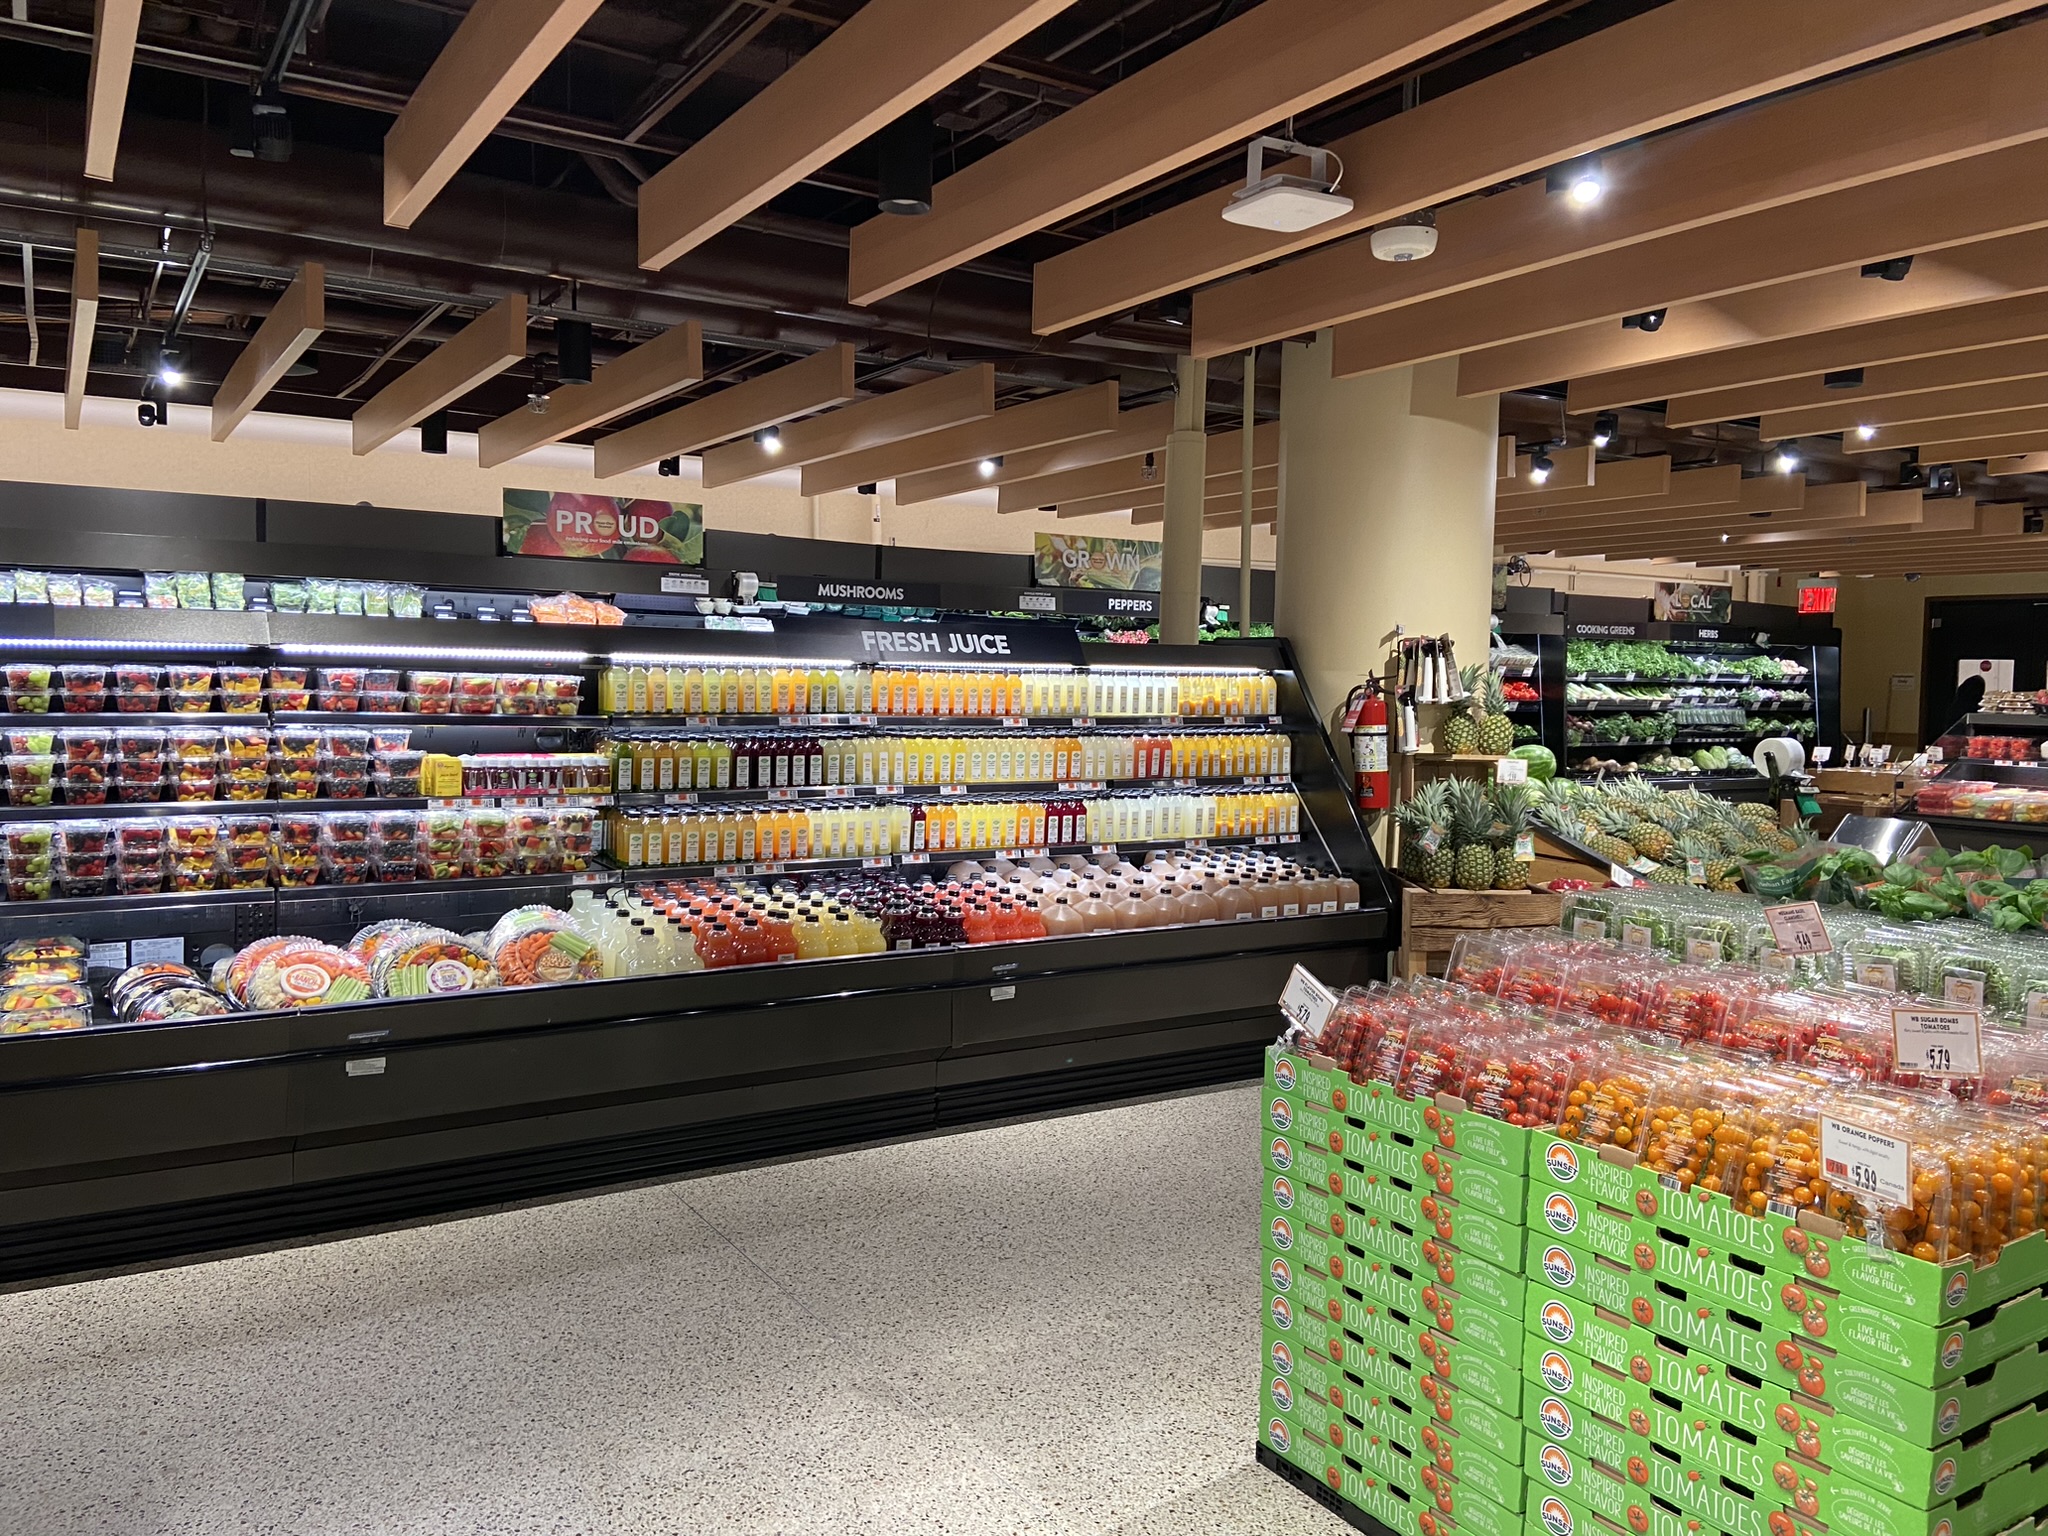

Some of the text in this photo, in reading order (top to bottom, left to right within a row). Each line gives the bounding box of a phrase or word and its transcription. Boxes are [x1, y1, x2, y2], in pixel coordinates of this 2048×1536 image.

[818, 584, 904, 600] MUSHROOMS
[1108, 598, 1153, 612] PEPPERS
[861, 630, 1011, 655] FRESH JUICE
[1576, 624, 1635, 636] COOKING GREENS
[1698, 628, 1719, 639] HERBS
[1926, 1048, 1951, 1070] $5.79
[1274, 1073, 1296, 1085] SUNSET
[1302, 1070, 1331, 1090] INSPIRED
[1303, 1085, 1328, 1104] FLAVOR
[1271, 1112, 1292, 1124] SUNSET
[1298, 1110, 1328, 1130] INSPIRED
[1348, 1087, 1420, 1134] TOMATOES
[1300, 1125, 1326, 1146] FLAVOR
[1467, 1140, 1500, 1157] FLAVOR FULLY
[1472, 1134, 1494, 1148] LIVE LIFE
[1832, 1122, 1895, 1149] WB ORANGE POPPERS
[1272, 1152, 1292, 1164] SUNSET
[1298, 1150, 1328, 1172] INSPIRED
[1344, 1130, 1418, 1180] TOMATOES
[1546, 1159, 1578, 1176] SUNSET
[1300, 1165, 1326, 1186] FLAVOR
[1588, 1158, 1632, 1188] INSPIRED
[1852, 1164, 1877, 1192] $5.99
[1880, 1178, 1905, 1191] Canada
[1344, 1172, 1417, 1224] TOMATOES
[1464, 1187, 1498, 1206] FLAVOR FULLY
[1470, 1182, 1492, 1196] LIVE LIFE
[1590, 1177, 1629, 1206] FLAVOR
[1300, 1191, 1328, 1214] INSPIRED
[1301, 1205, 1328, 1228] FLAVOR
[1545, 1210, 1577, 1228] SUNSET
[1586, 1211, 1632, 1242] INSPIRED
[1660, 1187, 1774, 1254] TOMATOES
[1272, 1230, 1292, 1243] SUNSET
[1299, 1232, 1328, 1256] INSPIRED
[1346, 1213, 1418, 1266] TOMATOES
[1588, 1229, 1627, 1259] FLAVOR
[1300, 1246, 1326, 1270] FLAVOR
[1345, 1256, 1417, 1312] TOMATES
[1544, 1262, 1575, 1281] SUNSET
[1584, 1264, 1630, 1296] INSPIRED
[1658, 1240, 1772, 1312] TOMATOES
[1852, 1268, 1903, 1294] FLAVOR FULLY
[1861, 1262, 1896, 1281] LIVE LIFE
[1298, 1273, 1327, 1299] INSPIRED
[1586, 1282, 1626, 1313] FLAVOR
[1946, 1287, 1968, 1298] SUNSET
[1299, 1288, 1325, 1312] FLAVOR
[1298, 1312, 1328, 1338] INSPIRED
[1343, 1299, 1416, 1358] TOMATOES
[1542, 1318, 1574, 1337] SUNSET
[1848, 1306, 1902, 1330] GREENHOUSE GROWN
[1300, 1326, 1326, 1351] FLAVOR
[1582, 1320, 1628, 1354] INSPIRED
[1656, 1298, 1767, 1372] TOMATES
[1848, 1328, 1900, 1356] FLAVOR FULLY
[1857, 1323, 1892, 1344] LIVE LIFE
[1584, 1340, 1624, 1370] FLAVOR
[1298, 1358, 1328, 1385] INSPIRED
[1344, 1339, 1416, 1400] TOMATOES
[1542, 1367, 1572, 1387] SUNSET
[1300, 1372, 1326, 1400] FLAVOR
[1582, 1372, 1626, 1406] INSPIRED
[1656, 1354, 1766, 1430] TOMATES
[1298, 1394, 1328, 1422] INSPIRED
[1344, 1388, 1416, 1450] TOMATES
[1584, 1390, 1622, 1423] FLAVOR
[1300, 1409, 1326, 1435] FLAVOR
[1540, 1414, 1572, 1434] SUNSET
[1581, 1418, 1625, 1454] INSPIRED
[1652, 1408, 1763, 1486] TOMATES
[1296, 1436, 1326, 1465] INSPIRED
[1344, 1425, 1416, 1490] TOMATES
[1584, 1438, 1622, 1470] FLAVOR
[1541, 1460, 1572, 1481] SUNSET
[1581, 1466, 1624, 1502] INSPIRED
[1651, 1458, 1761, 1536] TOMATOES
[1342, 1468, 1415, 1536] TOMATOES
[1584, 1484, 1621, 1518] FLAVOR
[1542, 1512, 1572, 1534] SUNSET
